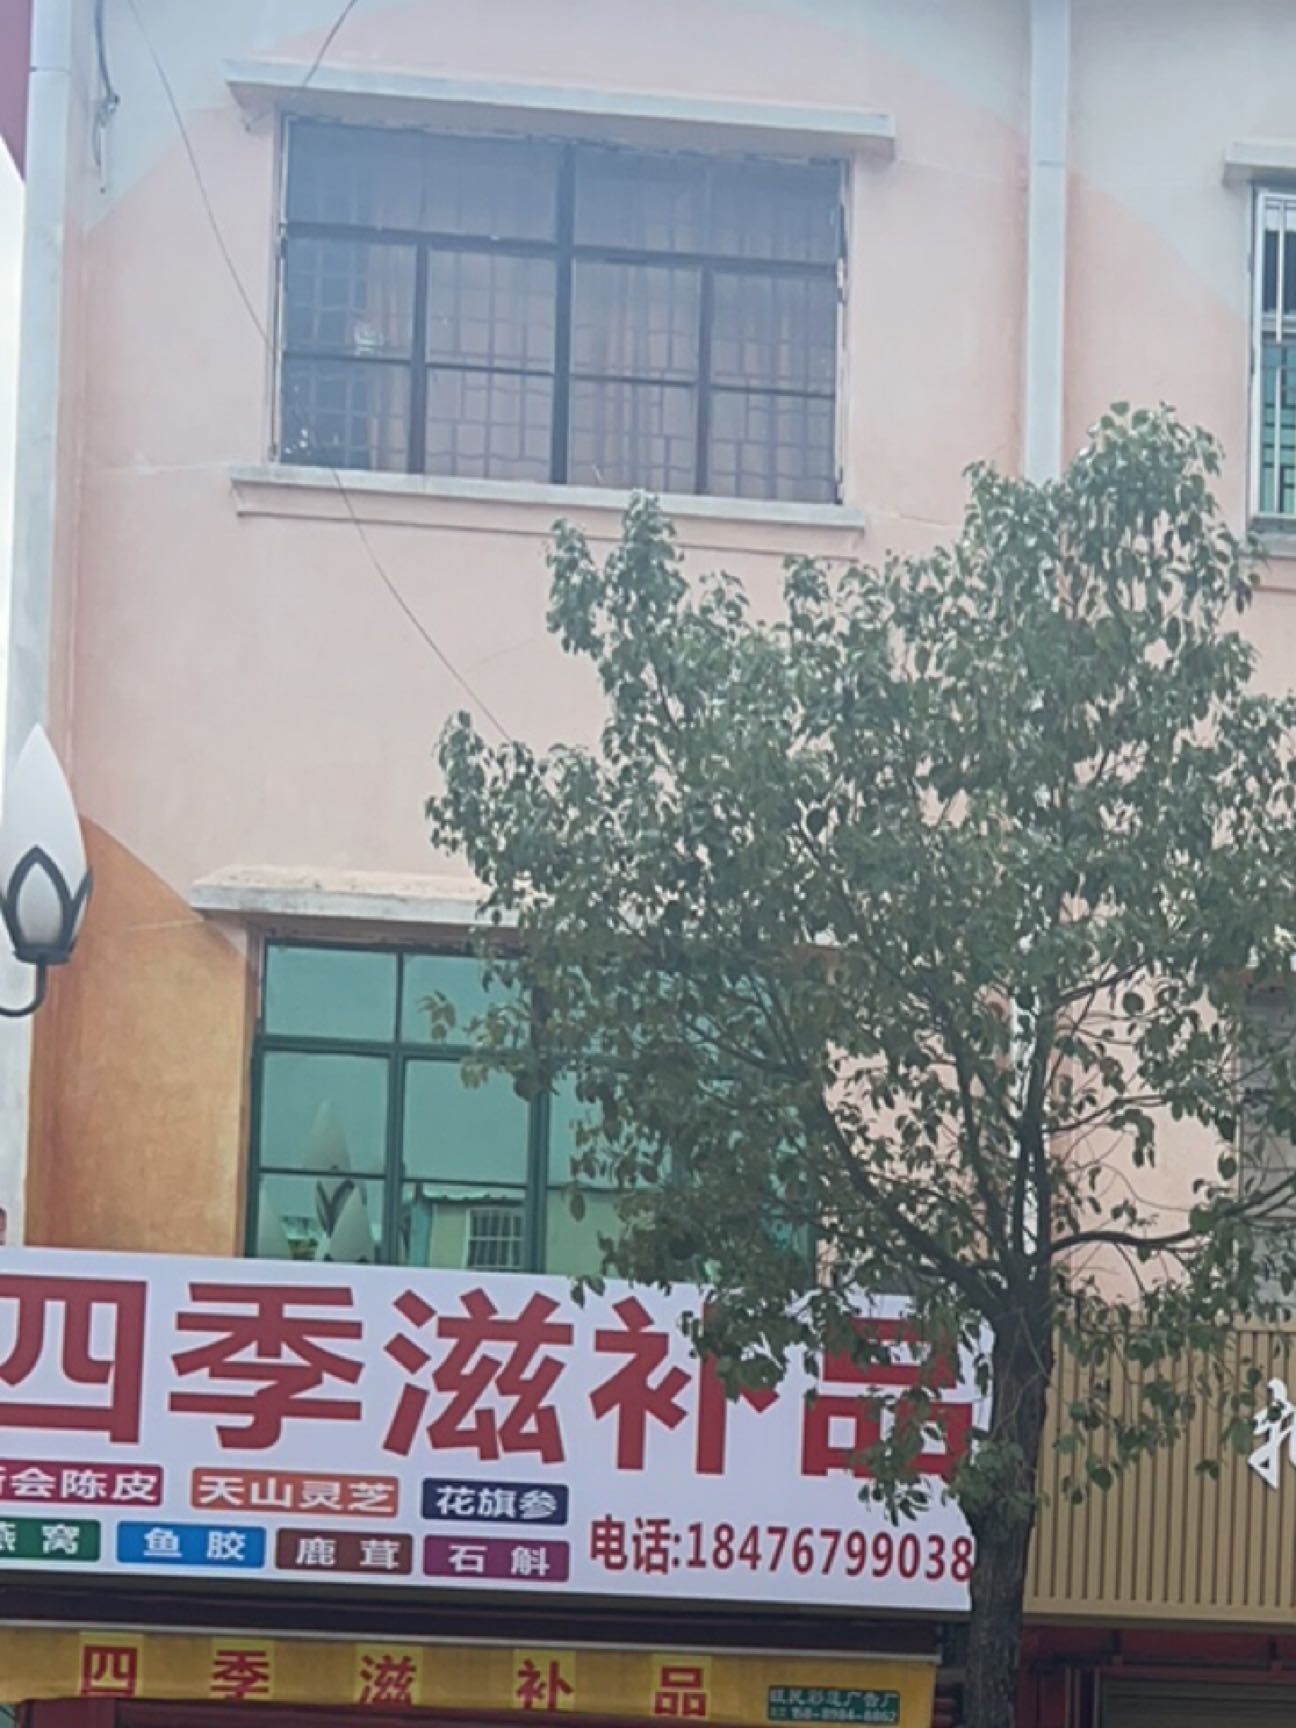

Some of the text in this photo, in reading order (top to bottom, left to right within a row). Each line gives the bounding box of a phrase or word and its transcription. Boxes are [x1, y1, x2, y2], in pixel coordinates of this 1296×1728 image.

[0, 1272, 974, 1480] 四季滋补品
[0, 1467, 557, 1519] 会陈皮 天山灵芝 花旗参
[143, 1526, 247, 1561] 鱼胶
[295, 1535, 401, 1570] 鹿茸
[448, 1544, 550, 1576] 石斛
[82, 1644, 708, 1718] 四季滋补品
